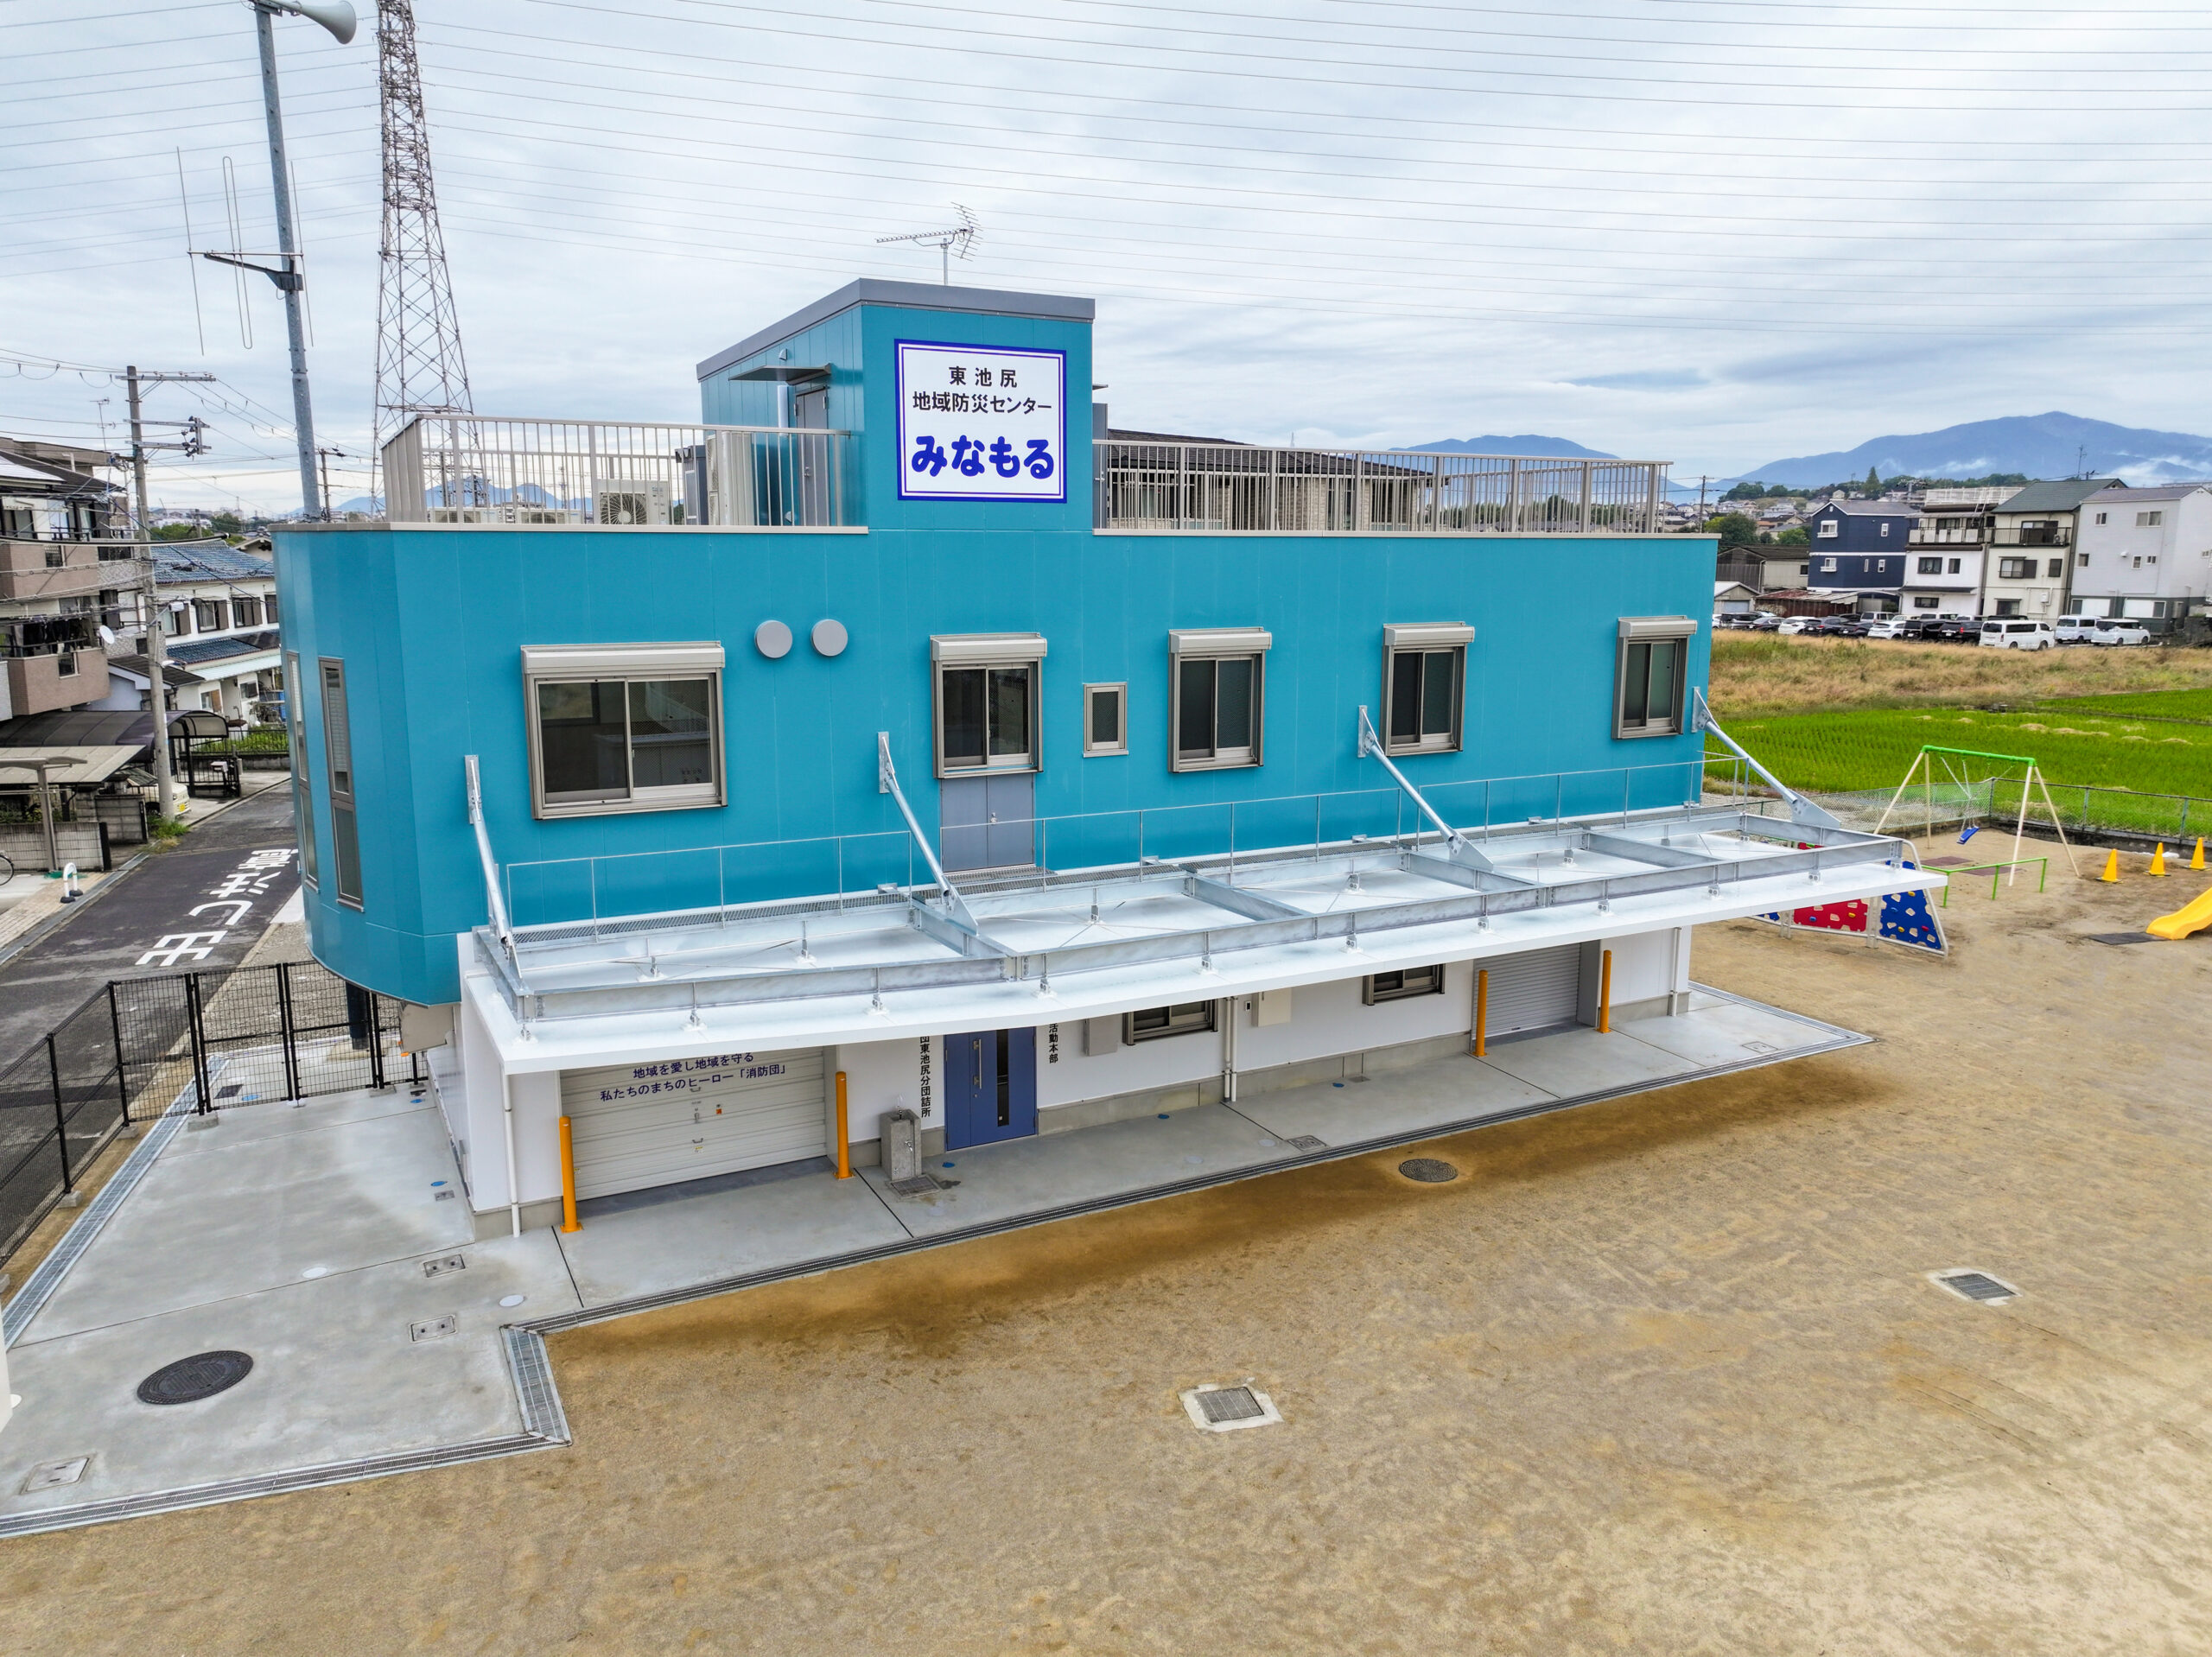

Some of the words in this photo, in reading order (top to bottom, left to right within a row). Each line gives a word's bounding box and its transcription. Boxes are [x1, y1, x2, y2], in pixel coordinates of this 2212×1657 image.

[949, 365, 1017, 388] 東池尻
[912, 391, 1052, 415] 地域防災センター
[912, 435, 1054, 479] みなもる
[632, 1052, 754, 1079] 地域を愛し地域を守る
[600, 1064, 786, 1102] 私たちのまちのヒーロー「消防団」
